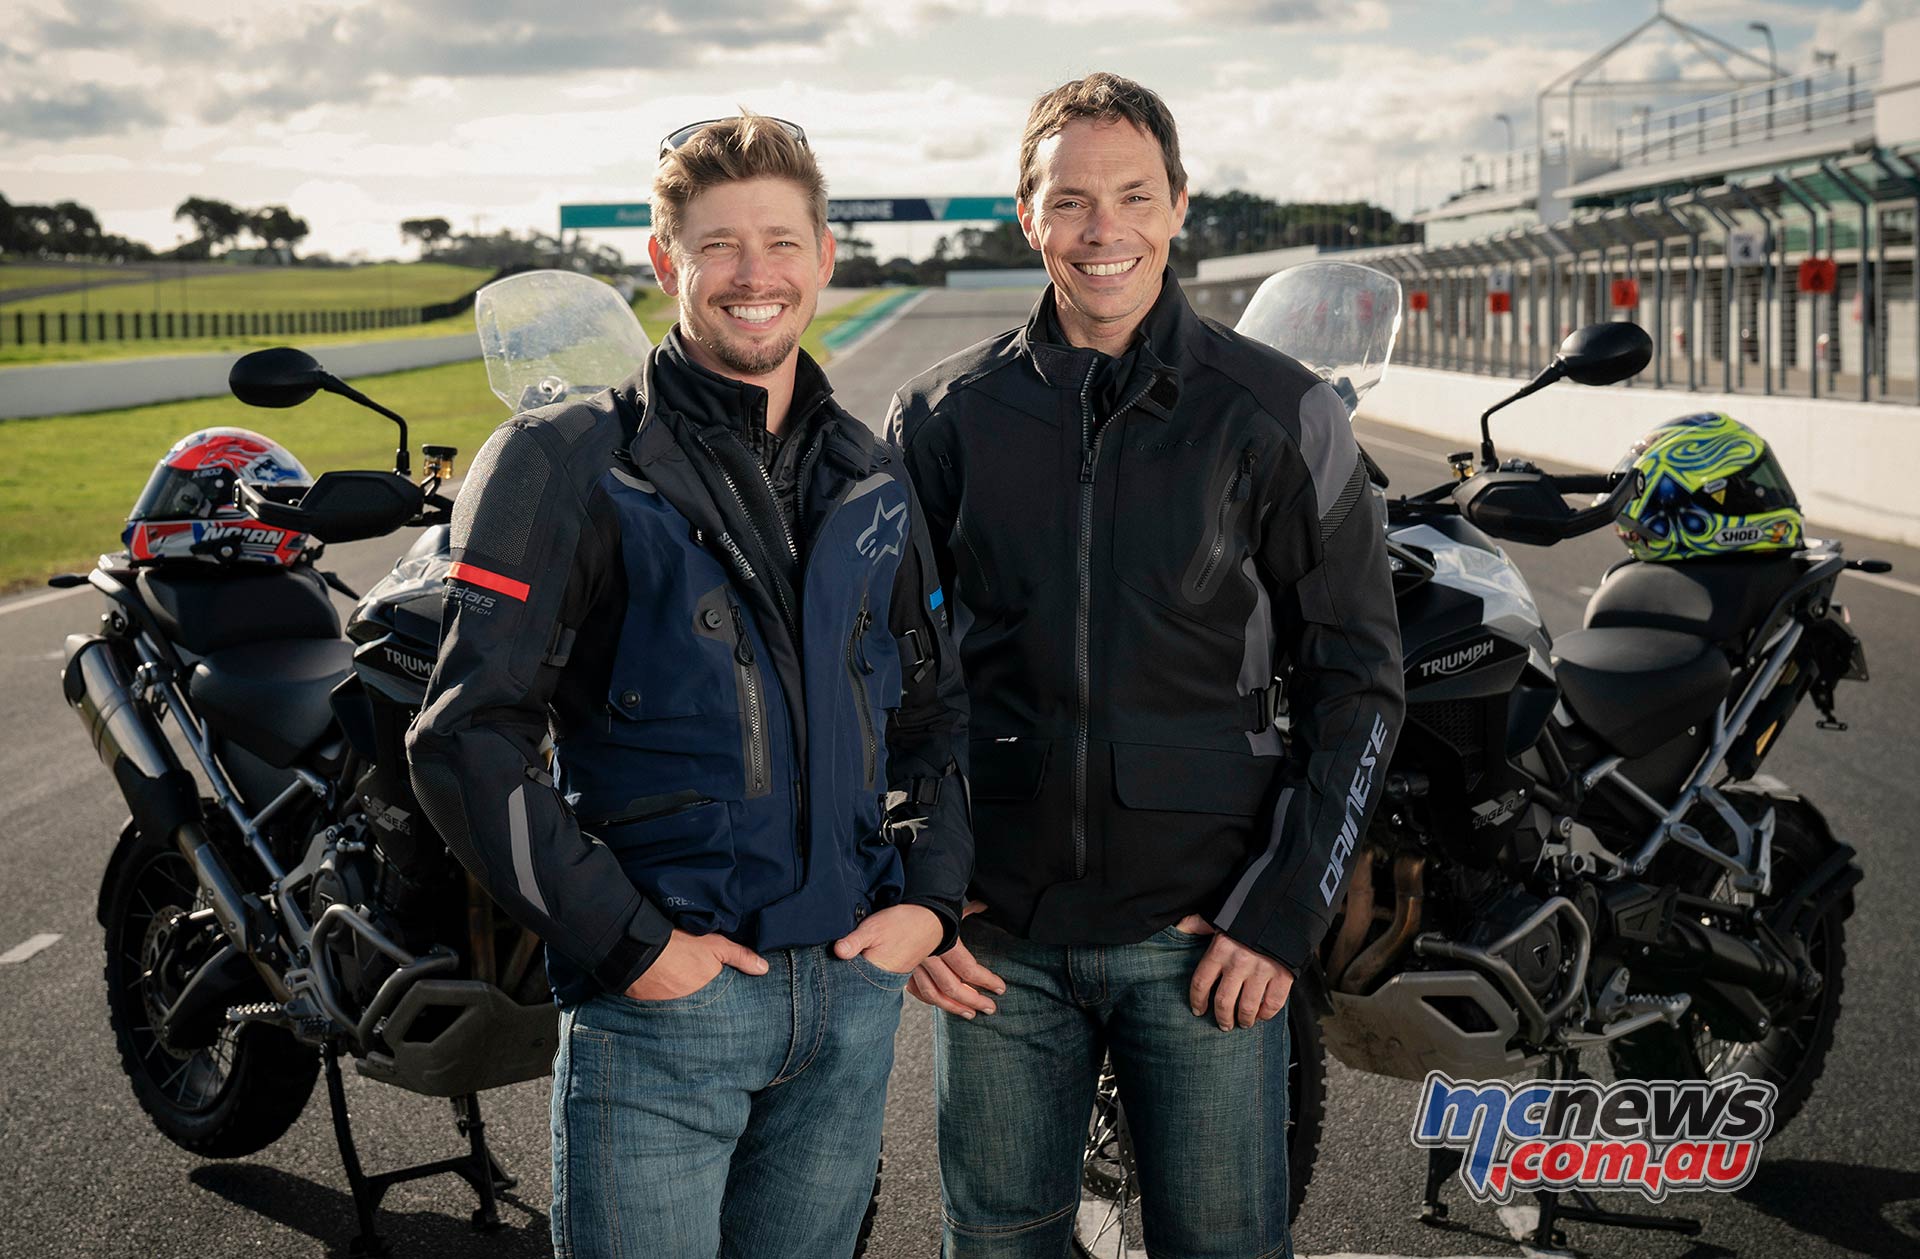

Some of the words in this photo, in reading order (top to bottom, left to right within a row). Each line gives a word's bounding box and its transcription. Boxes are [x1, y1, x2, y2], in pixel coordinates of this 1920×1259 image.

[1720, 529, 1759, 542] SHOEI
[1420, 639, 1494, 677] TRIUMPH
[1319, 711, 1388, 908] DAINESE
[1472, 798, 1515, 830] TIGER
